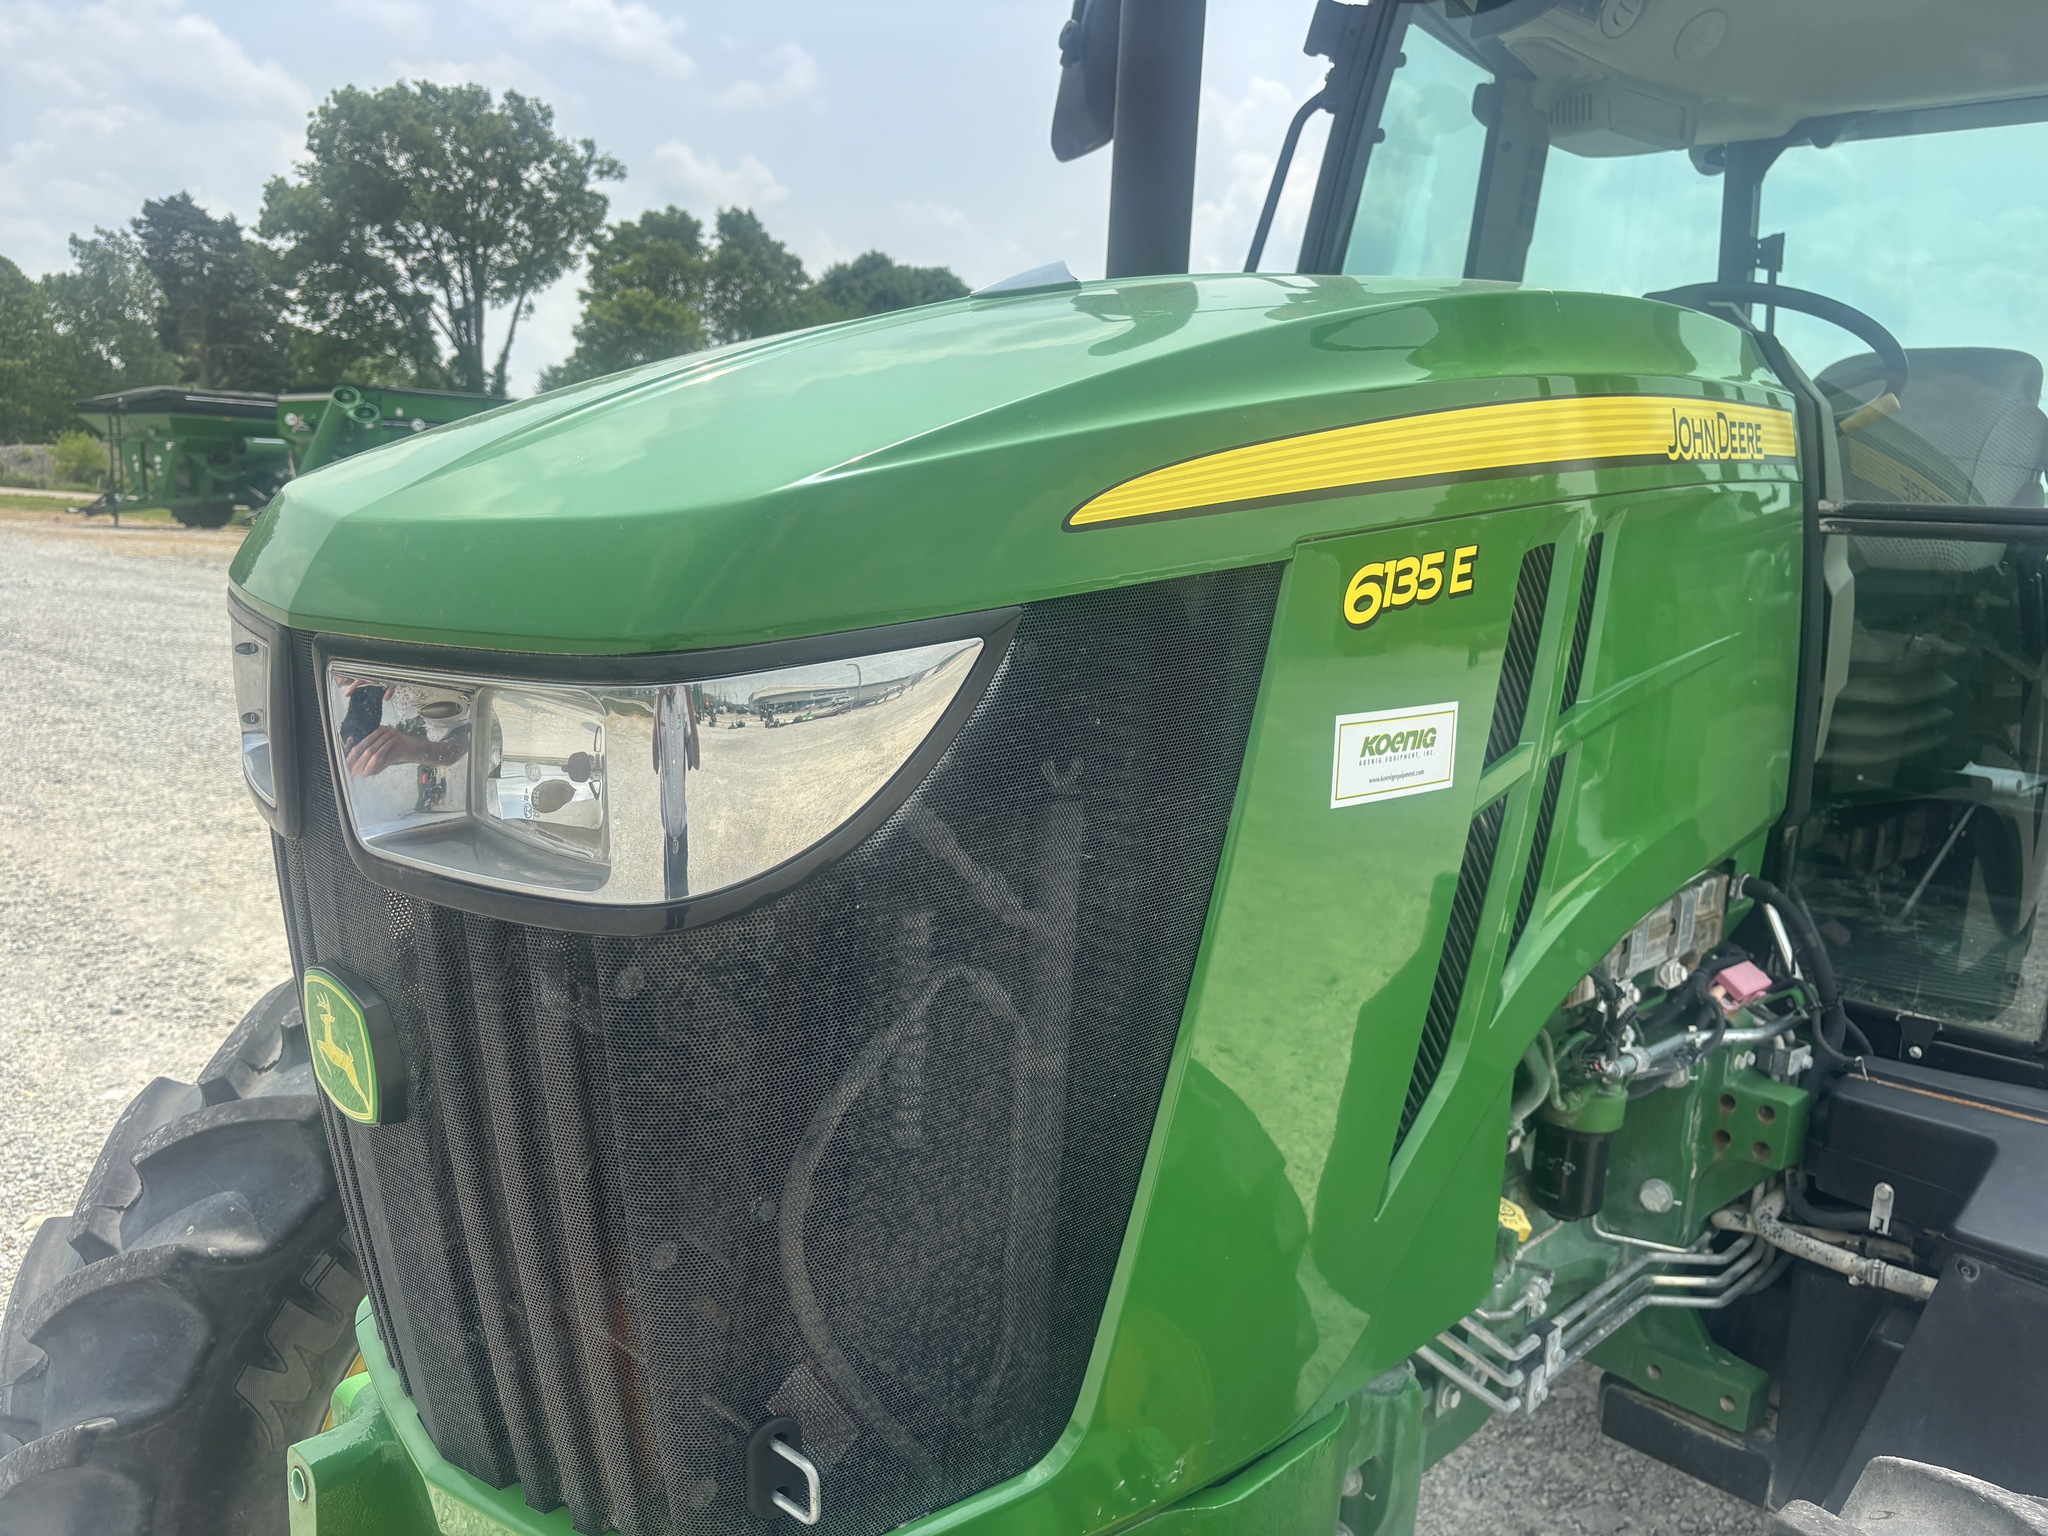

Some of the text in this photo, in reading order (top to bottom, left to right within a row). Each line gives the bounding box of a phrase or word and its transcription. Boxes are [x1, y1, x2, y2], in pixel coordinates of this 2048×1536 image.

[1667, 407, 1764, 457] JOHN DEERE
[1343, 544, 1478, 628] 6135 E
[1358, 757, 1382, 766] KOENIG
